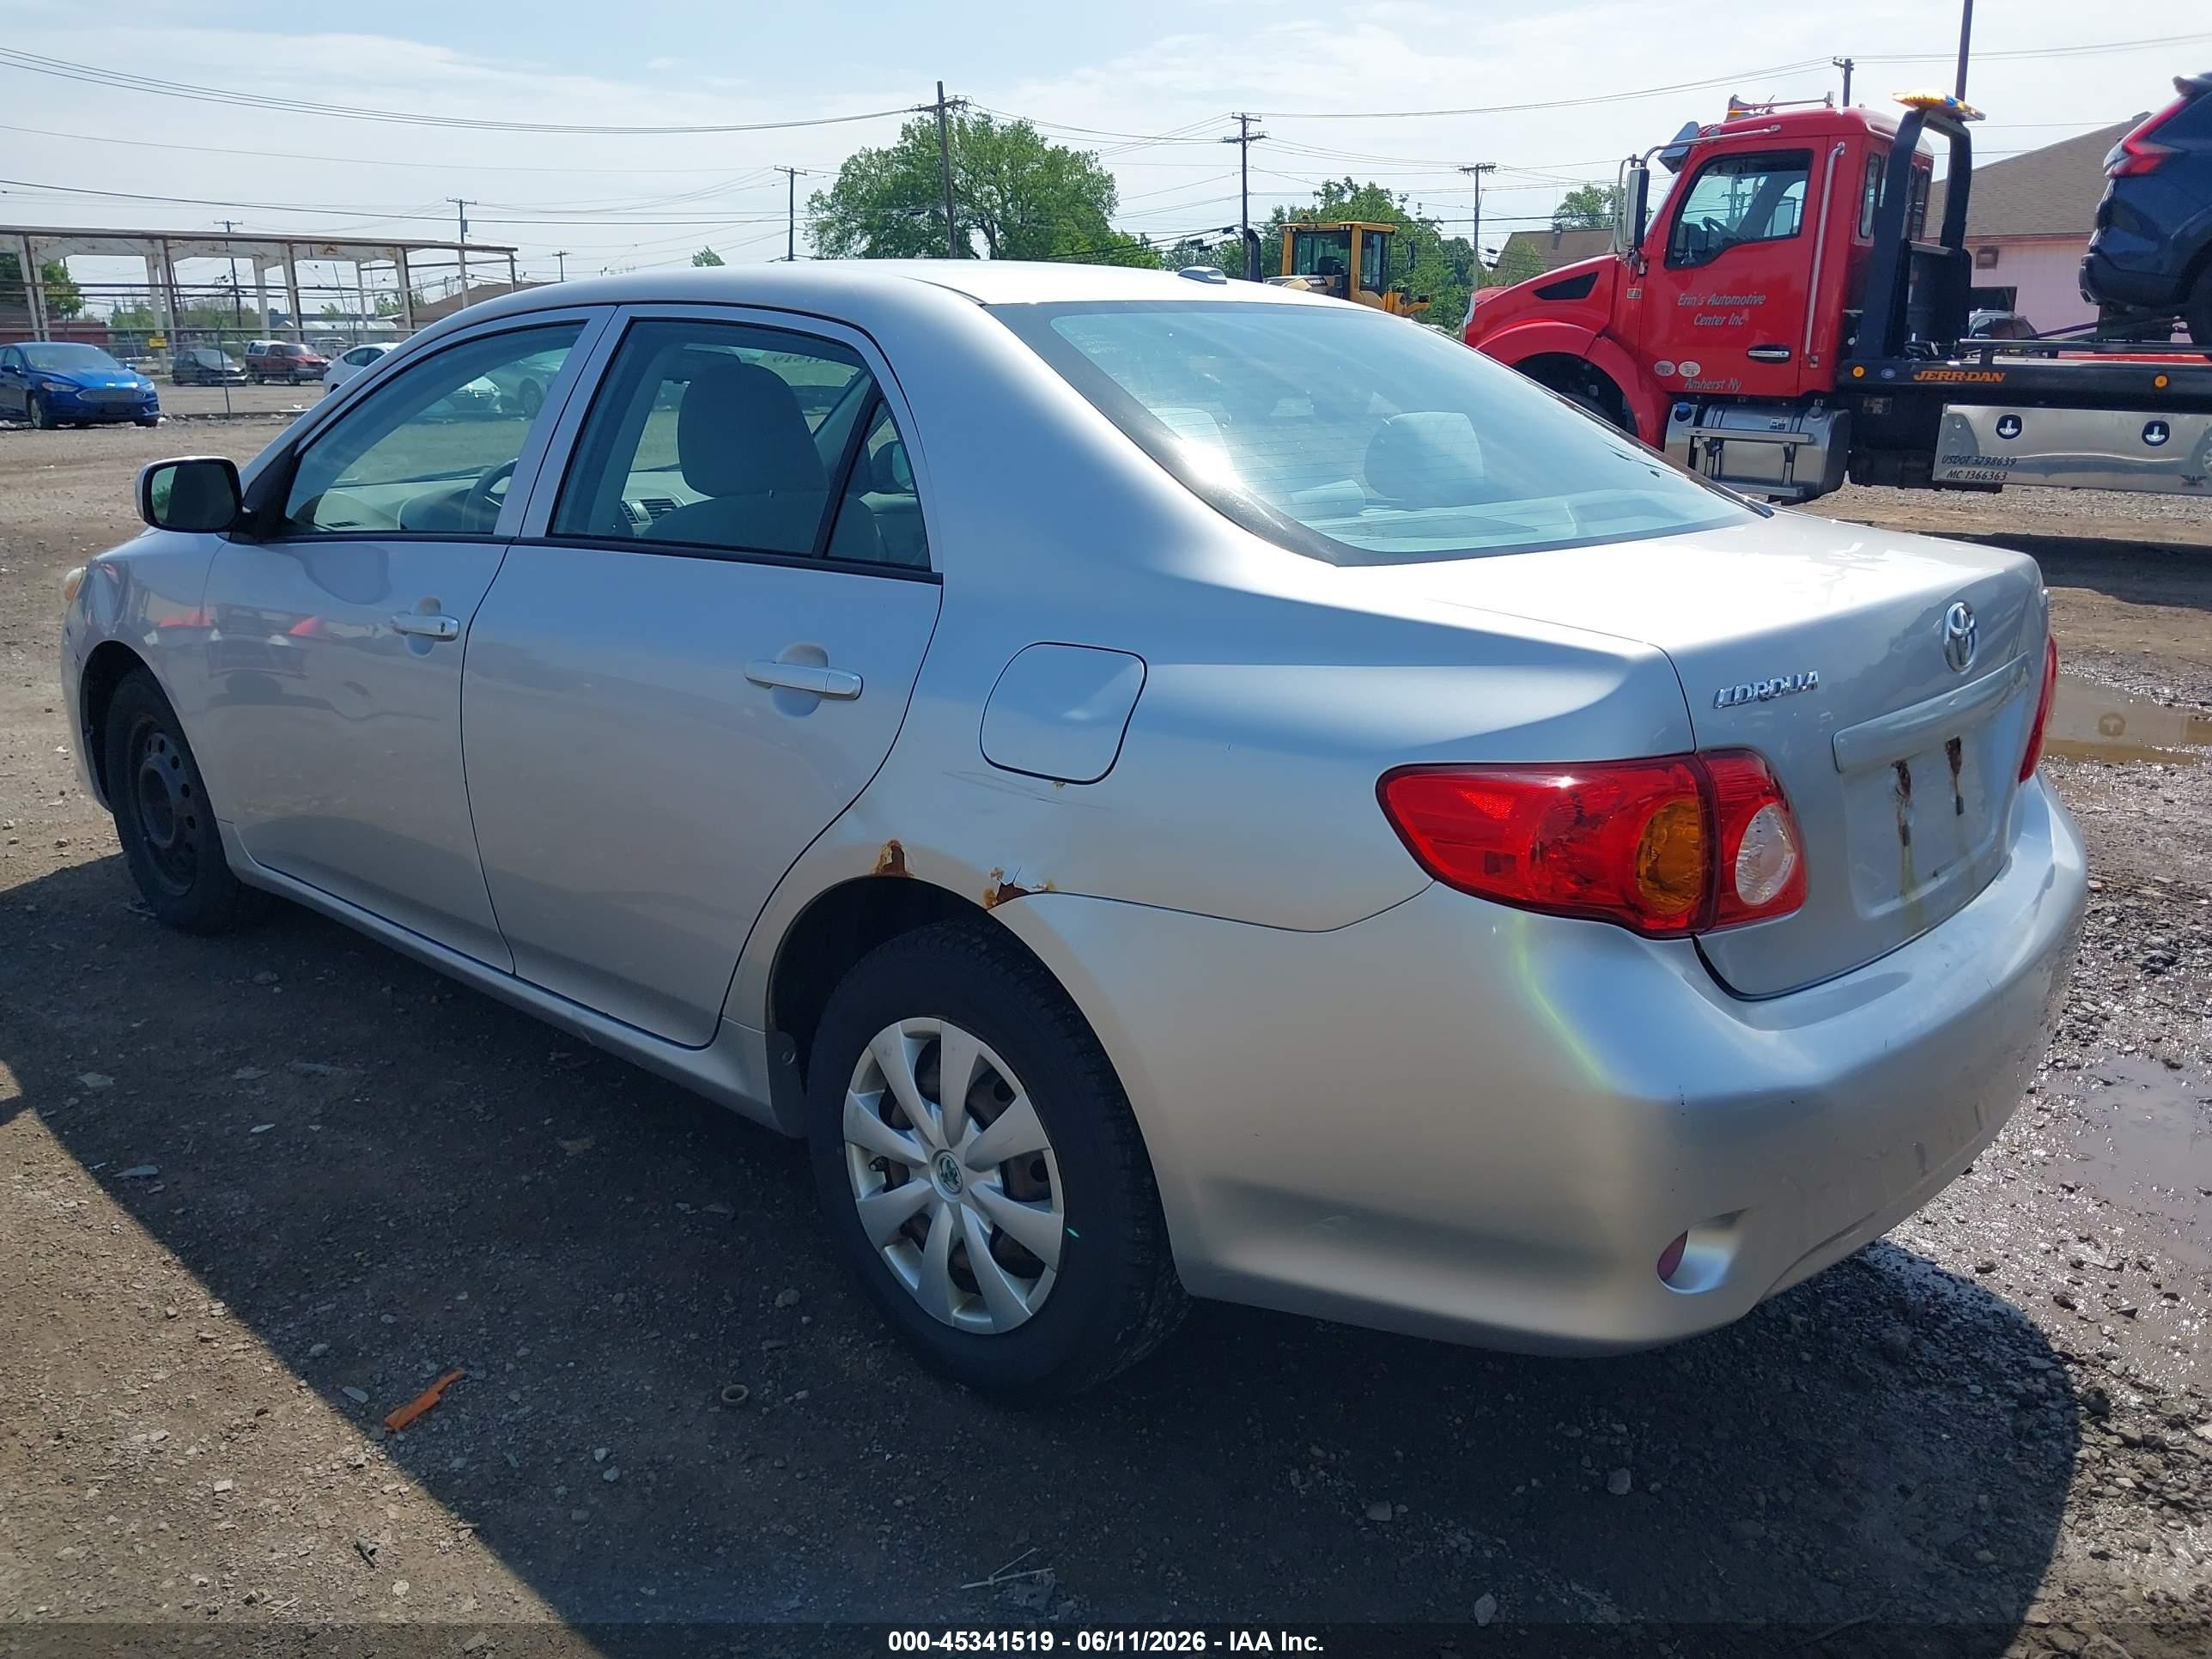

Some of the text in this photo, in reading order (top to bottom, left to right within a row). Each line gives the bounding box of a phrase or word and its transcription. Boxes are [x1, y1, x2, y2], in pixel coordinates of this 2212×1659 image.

[1677, 291, 1766, 306] Erin's Automotive
[1693, 313, 1745, 325] Center Inc
[1684, 378, 1725, 390] Amherst
[1942, 455, 1972, 465] USDOT
[1946, 470, 2008, 481] MC 1366363
[1713, 670, 1819, 708] COROLLA
